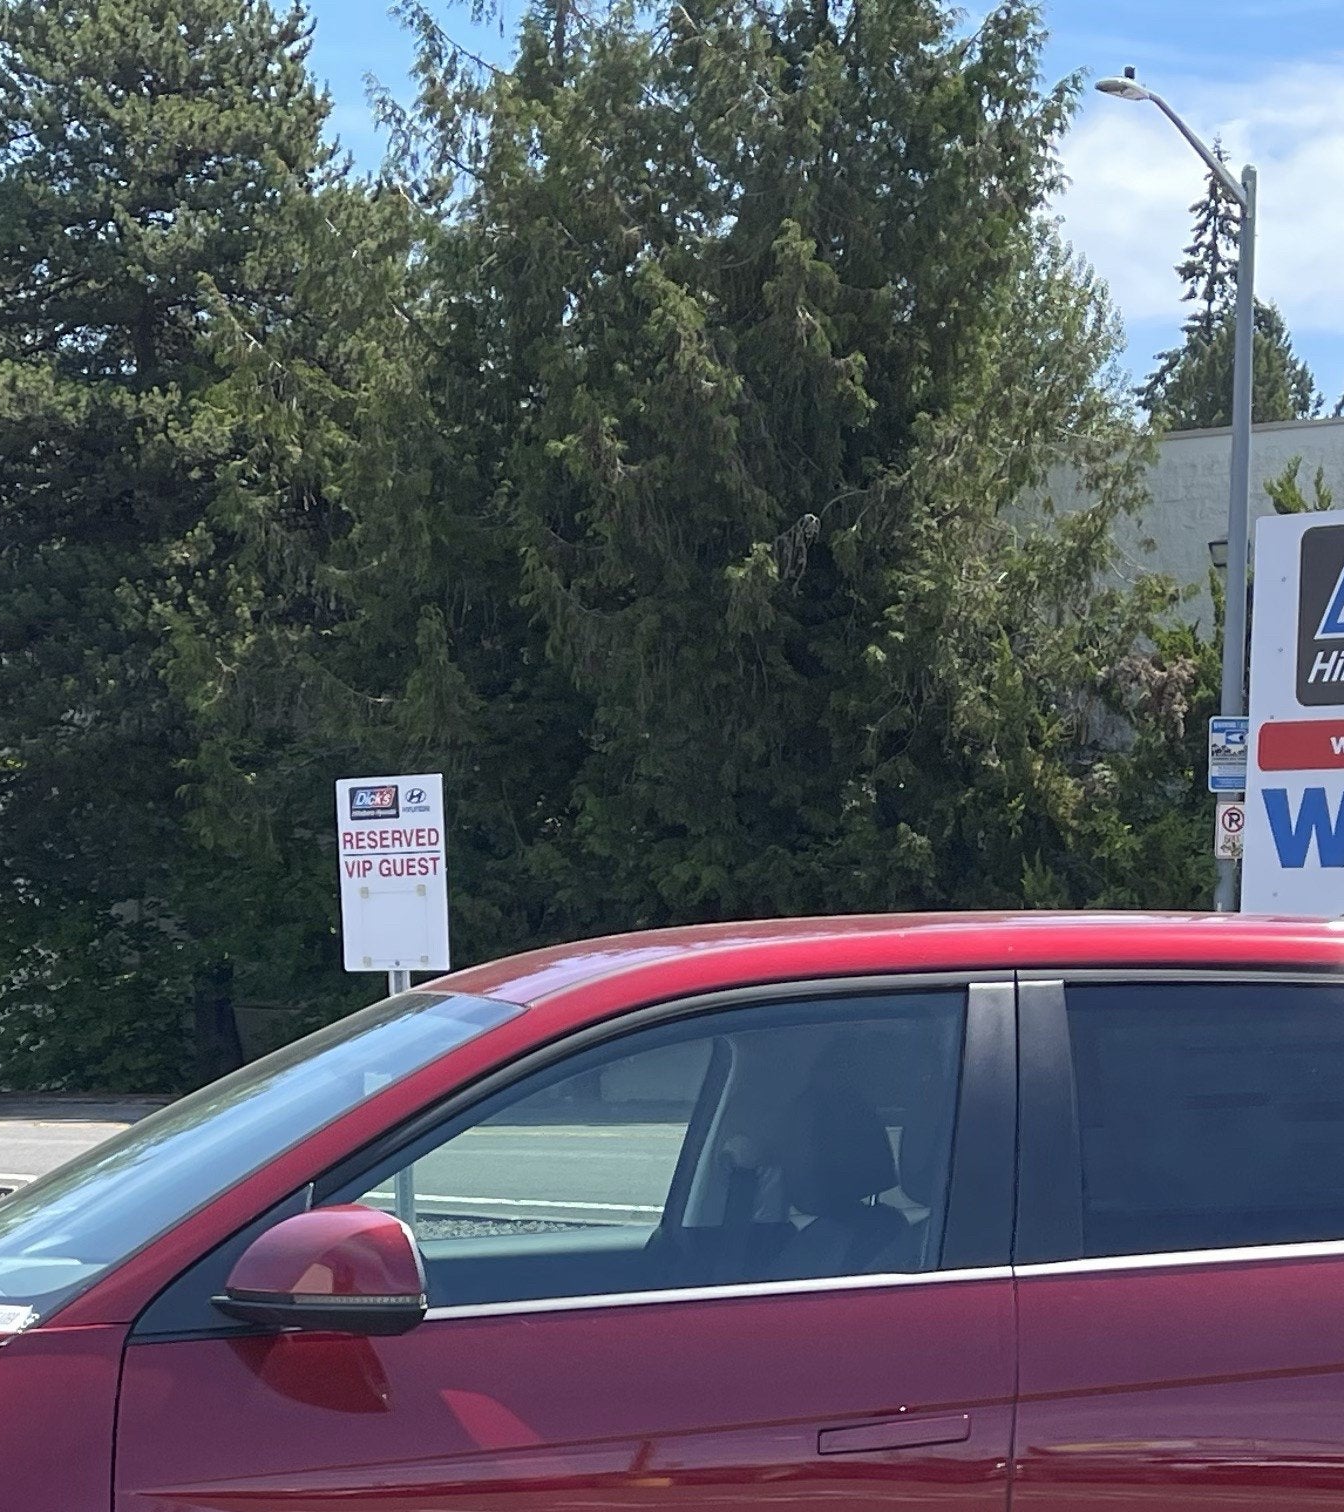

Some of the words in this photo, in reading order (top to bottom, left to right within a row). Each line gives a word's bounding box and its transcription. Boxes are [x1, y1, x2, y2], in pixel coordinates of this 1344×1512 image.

[342, 828, 440, 850] RESERVED
[344, 859, 373, 879] VIP
[379, 856, 441, 878] GUEST
